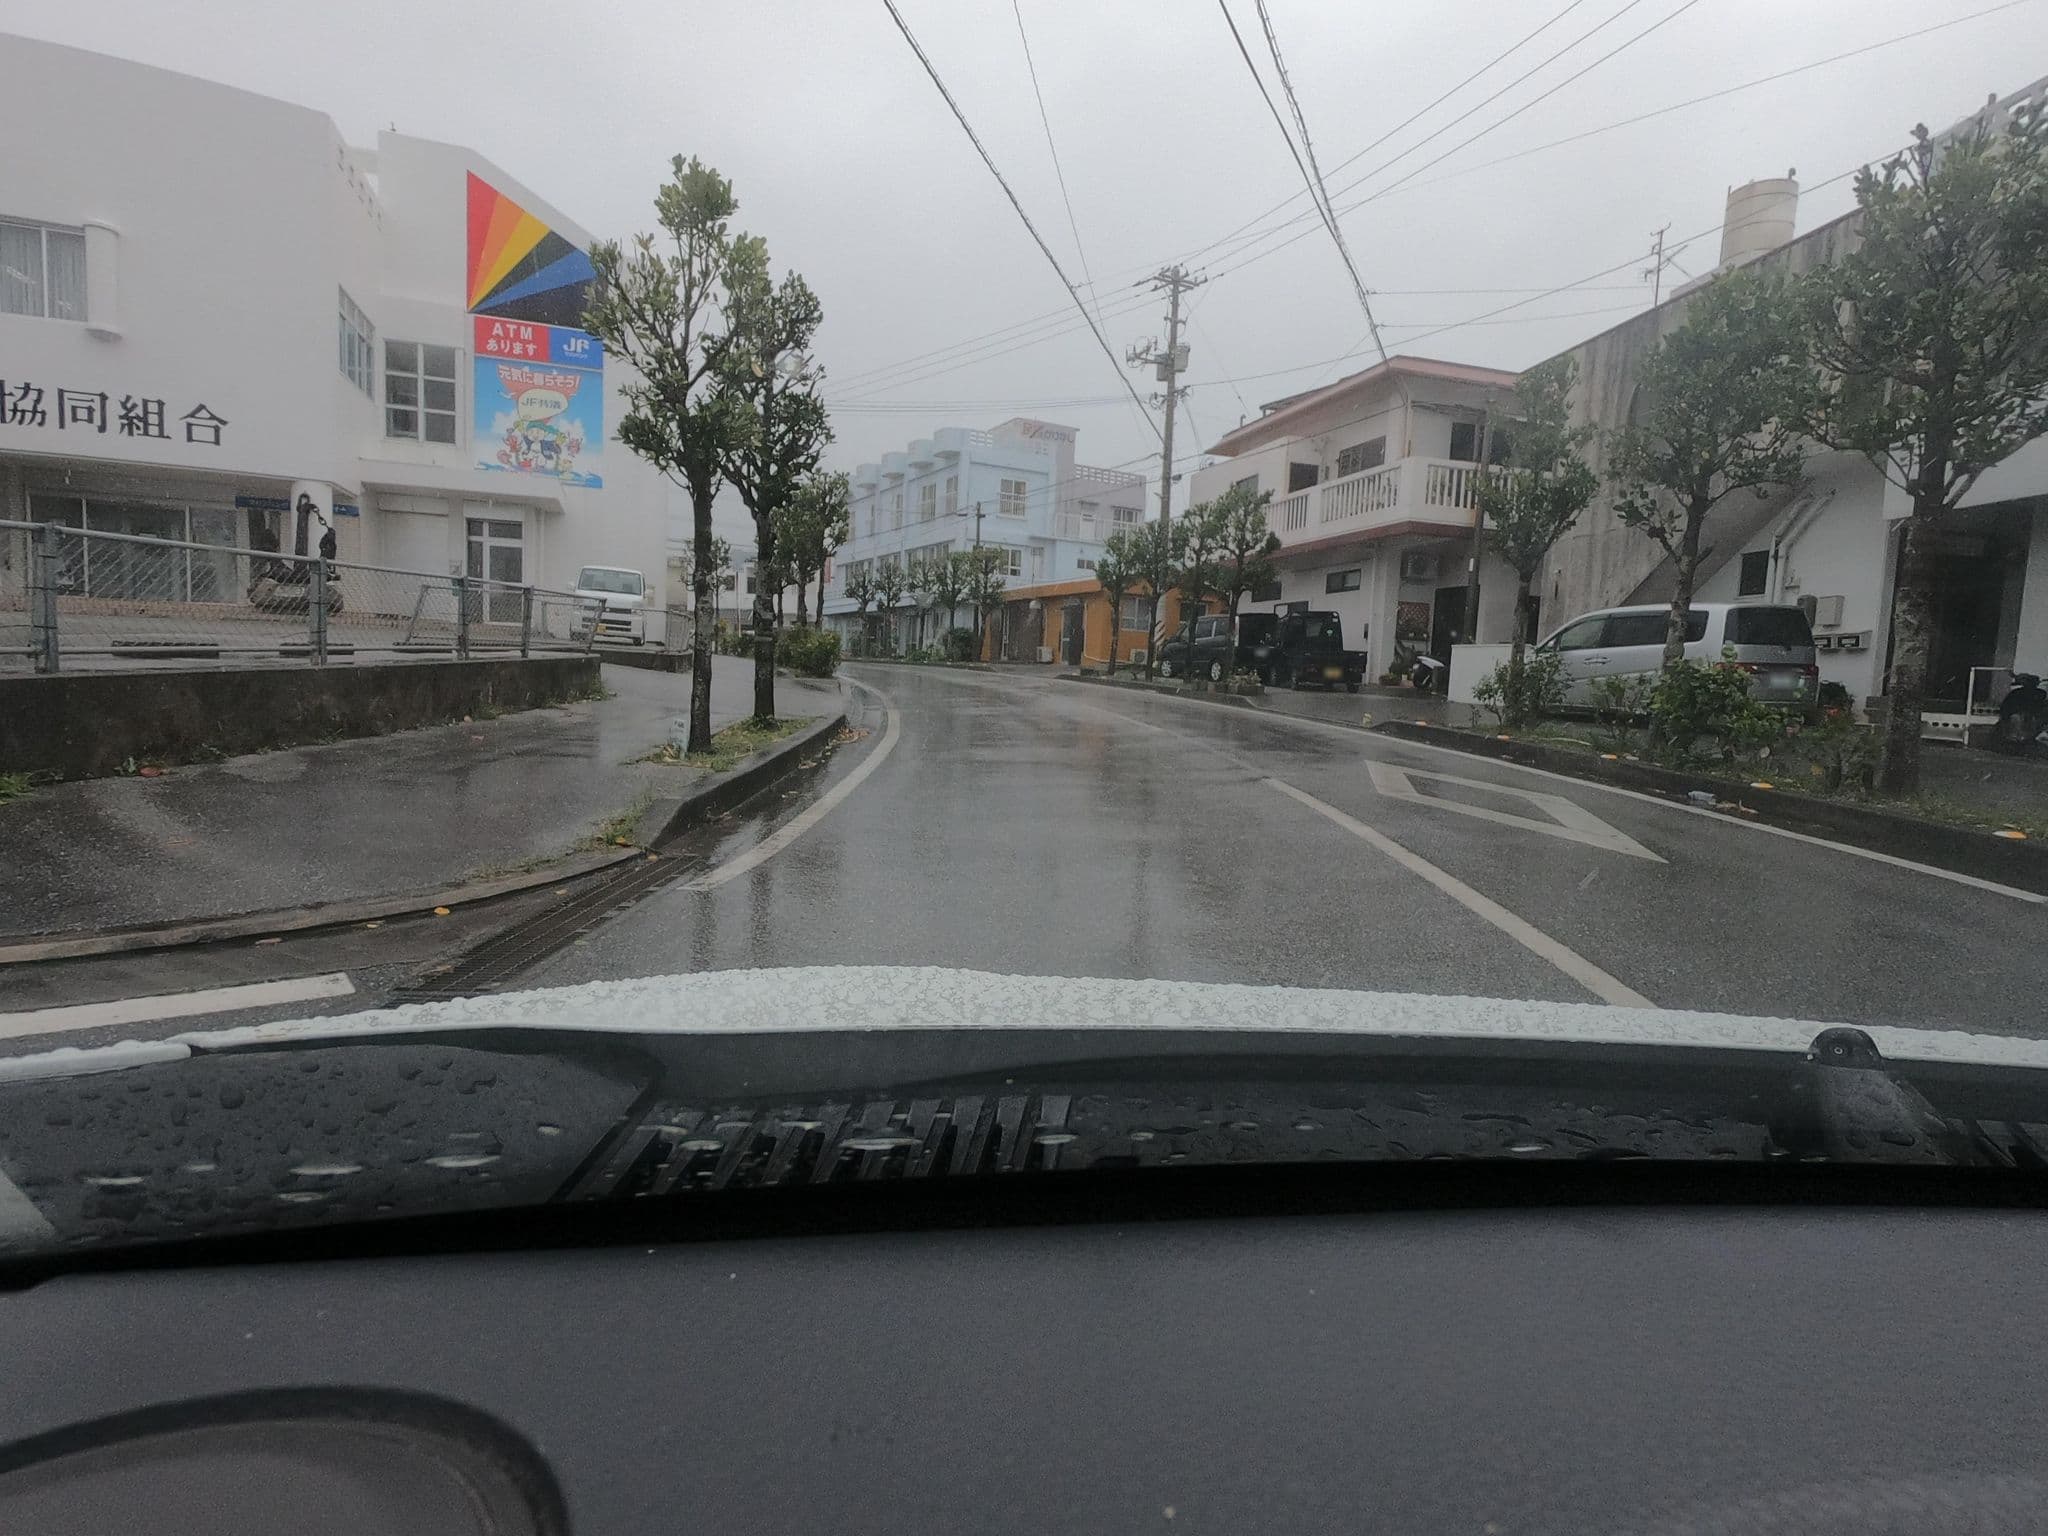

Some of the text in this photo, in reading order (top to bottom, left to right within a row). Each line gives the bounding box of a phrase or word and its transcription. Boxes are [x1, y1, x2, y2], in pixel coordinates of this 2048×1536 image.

[492, 322, 533, 341] ATM
[486, 338, 537, 356] あります
[0, 379, 229, 446] 協同組合
